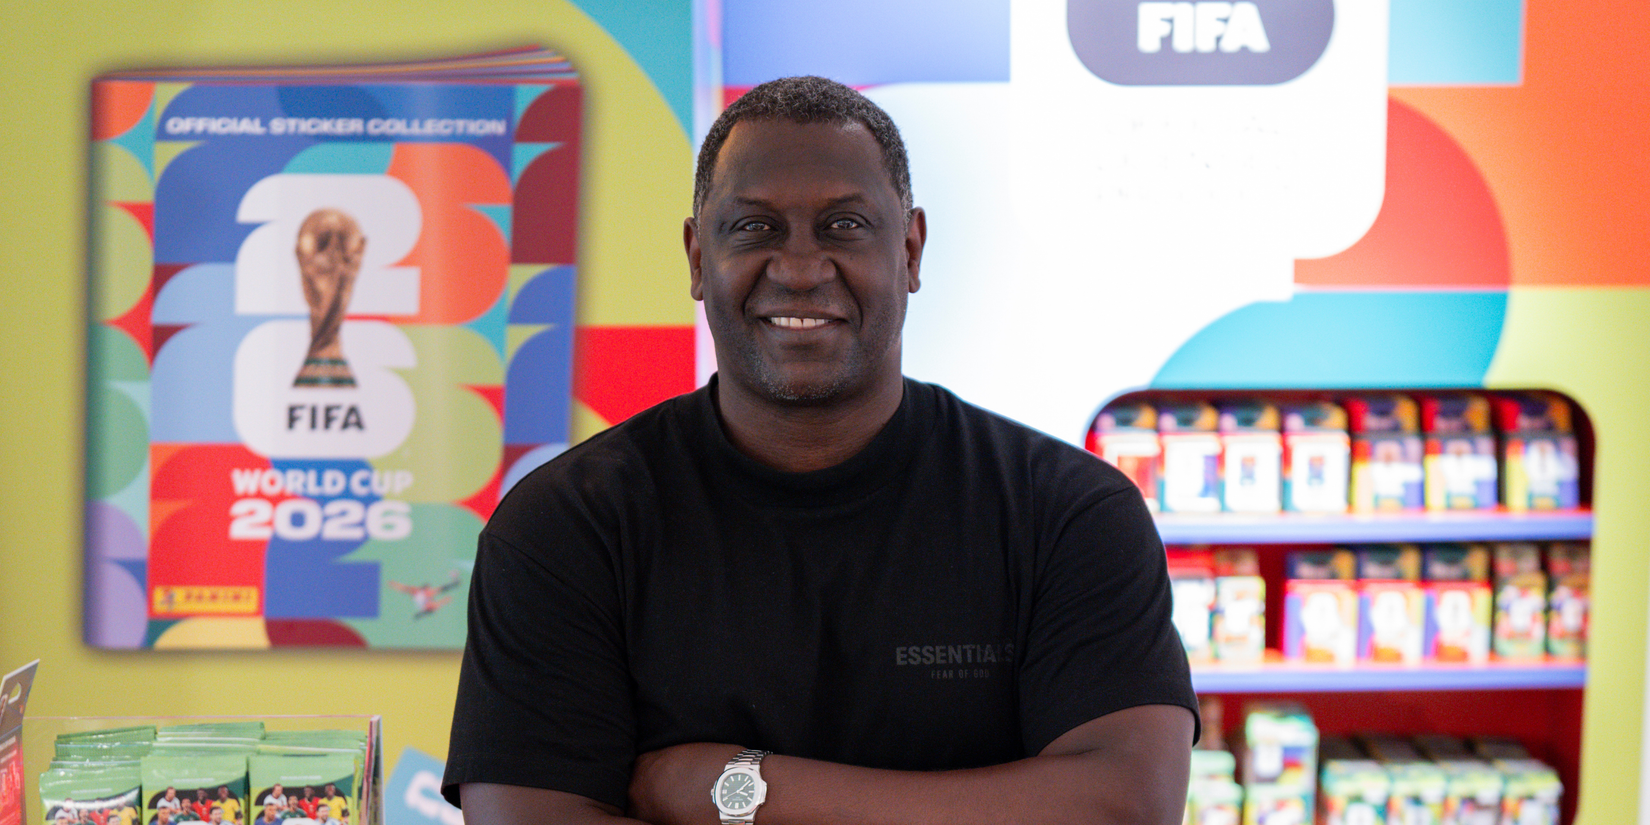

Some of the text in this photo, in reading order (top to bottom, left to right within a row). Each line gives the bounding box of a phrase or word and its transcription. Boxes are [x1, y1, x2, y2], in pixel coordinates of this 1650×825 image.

[1137, 1, 1270, 52] FIFA
[165, 117, 507, 135] OFFICIAL STICKER COLLECTION
[286, 404, 365, 431] FIFA
[231, 468, 413, 497] WORLD CUP
[229, 498, 413, 540] 2026
[931, 670, 954, 679] FEAR
[958, 669, 969, 679] OF
